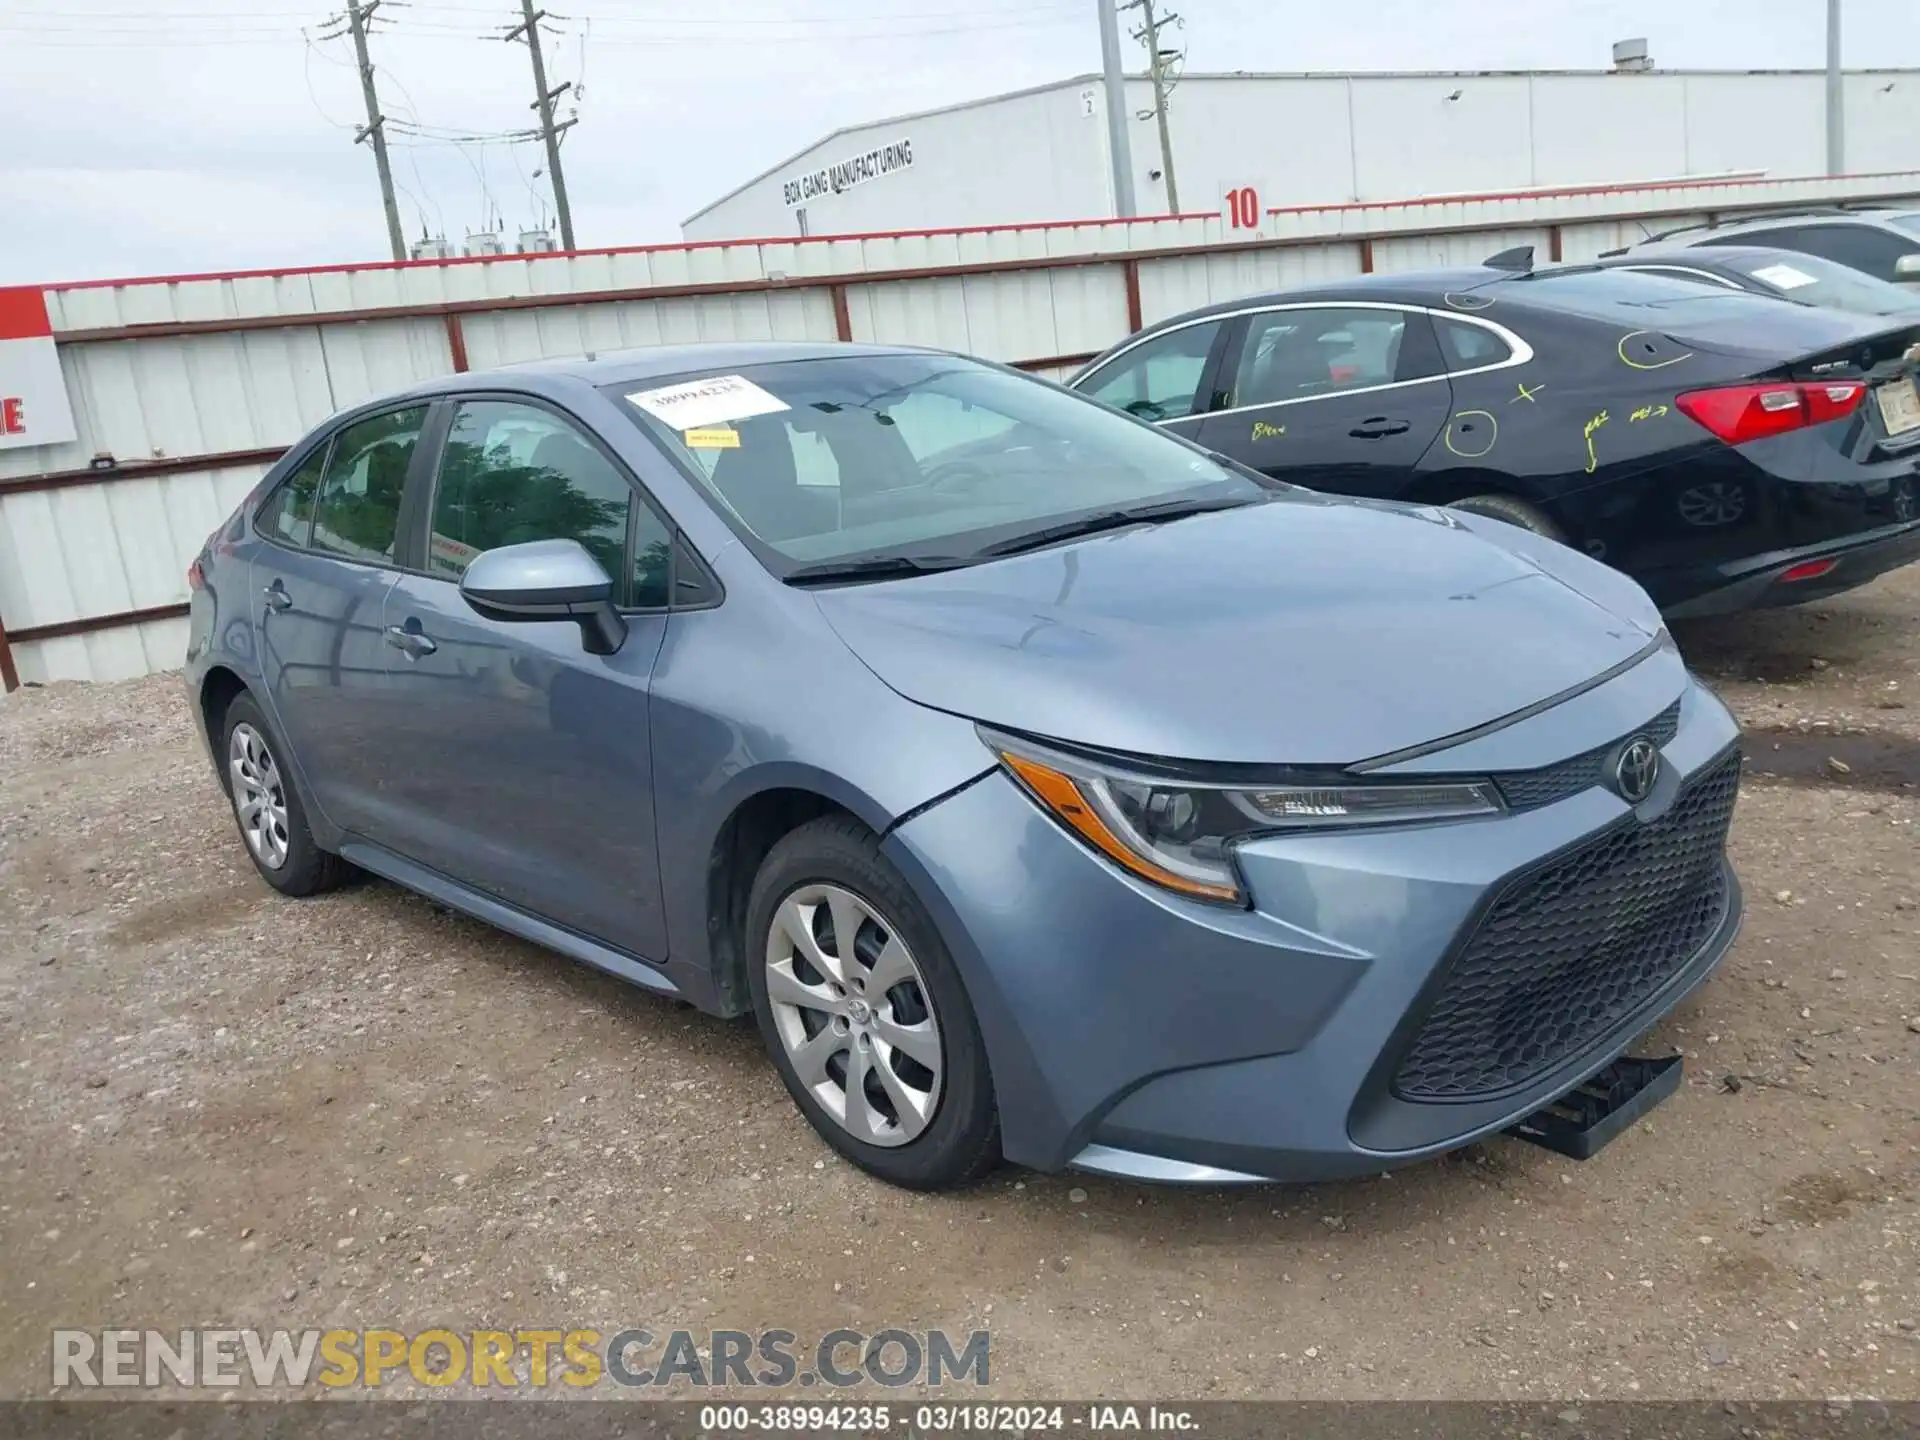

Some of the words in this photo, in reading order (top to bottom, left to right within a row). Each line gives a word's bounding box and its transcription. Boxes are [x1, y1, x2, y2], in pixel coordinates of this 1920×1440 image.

[784, 182, 802, 204] BOX
[803, 171, 829, 199] GANG
[829, 140, 912, 189] MANUFACTURING
[1225, 187, 1258, 228] 10
